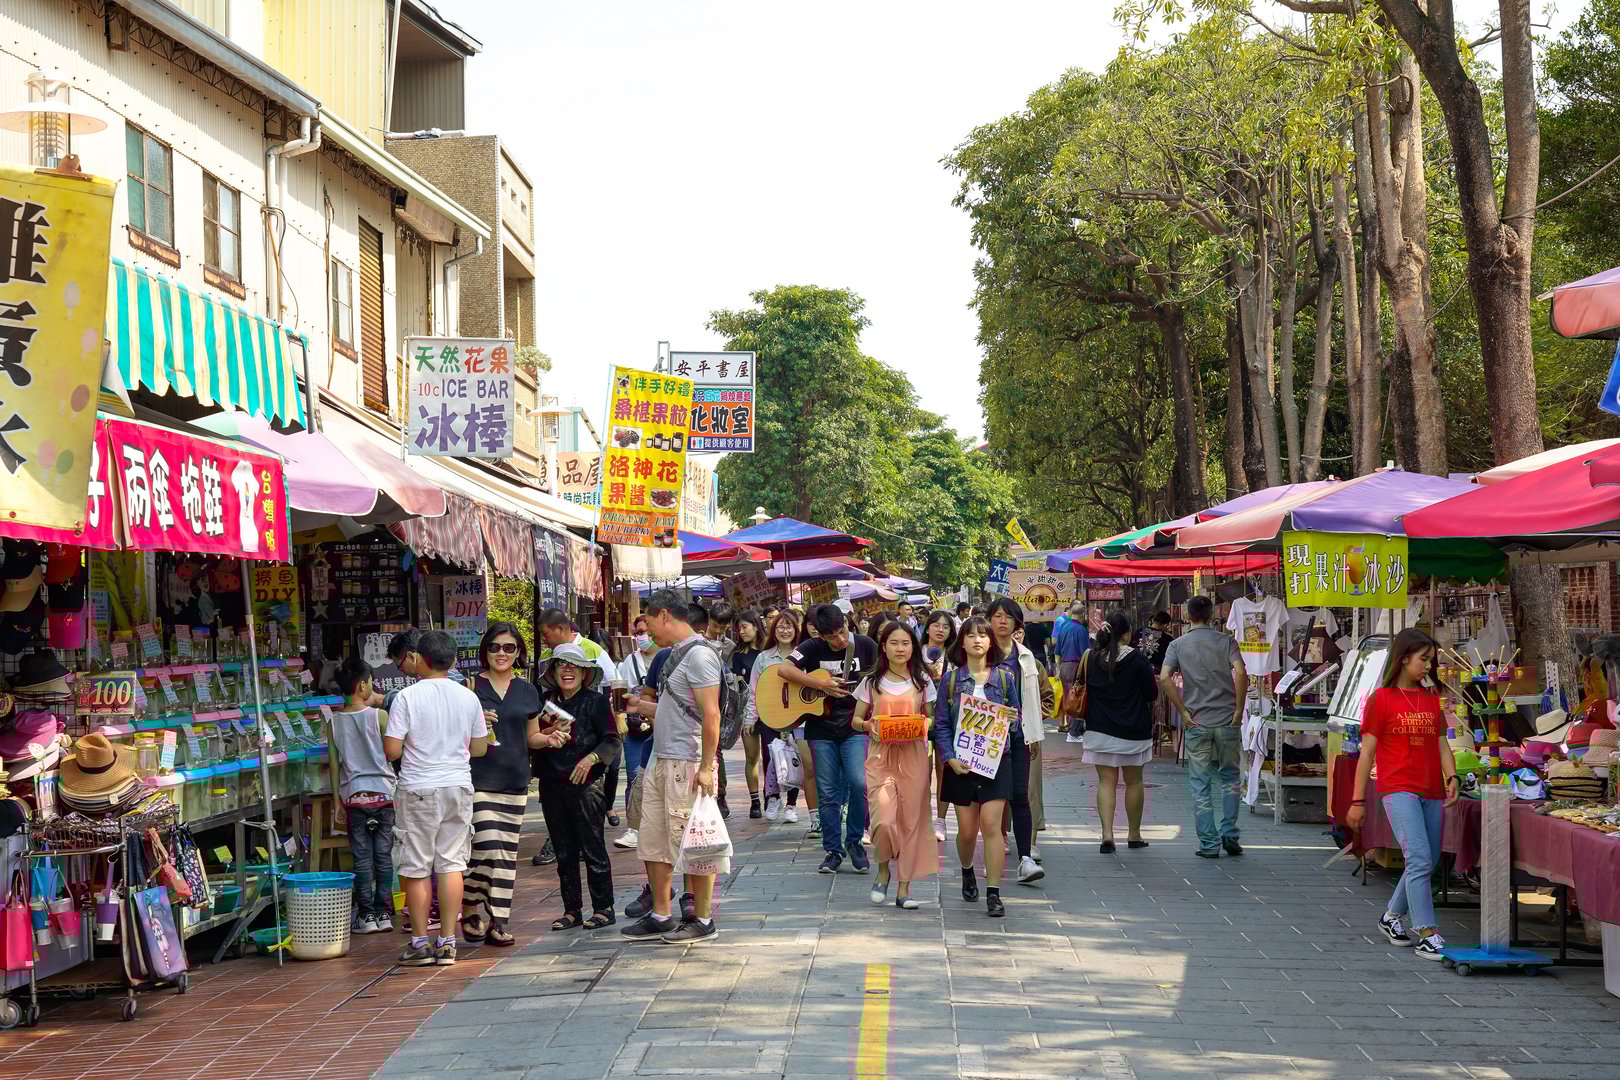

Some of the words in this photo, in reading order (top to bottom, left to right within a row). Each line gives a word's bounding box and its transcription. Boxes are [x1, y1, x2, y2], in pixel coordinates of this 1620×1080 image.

[414, 345, 510, 374] 天然花果
[674, 360, 749, 379] 安平書屋
[441, 378, 468, 398] ICE
[476, 379, 509, 399] BAR
[634, 376, 691, 397] 伴手好禮
[614, 397, 689, 427] 桑椹果粒
[690, 404, 750, 435] 化妝室
[414, 402, 508, 454] 冰棒
[609, 454, 679, 484] 洛神花
[608, 482, 646, 506] 果醬
[602, 511, 651, 526] ORGANIC
[653, 515, 677, 527] JAM
[602, 523, 653, 536] MULBERRY
[1287, 543, 1312, 595] 現打
[1314, 552, 1351, 593] 果汁
[1364, 552, 1405, 594] 冰沙
[255, 587, 296, 602] DIY
[455, 579, 483, 596] 冰棒
[454, 600, 484, 617] DIY
[92, 680, 132, 705] 100
[963, 697, 997, 714] AKGC
[1401, 718, 1433, 726] EDITION
[970, 756, 995, 775] House
